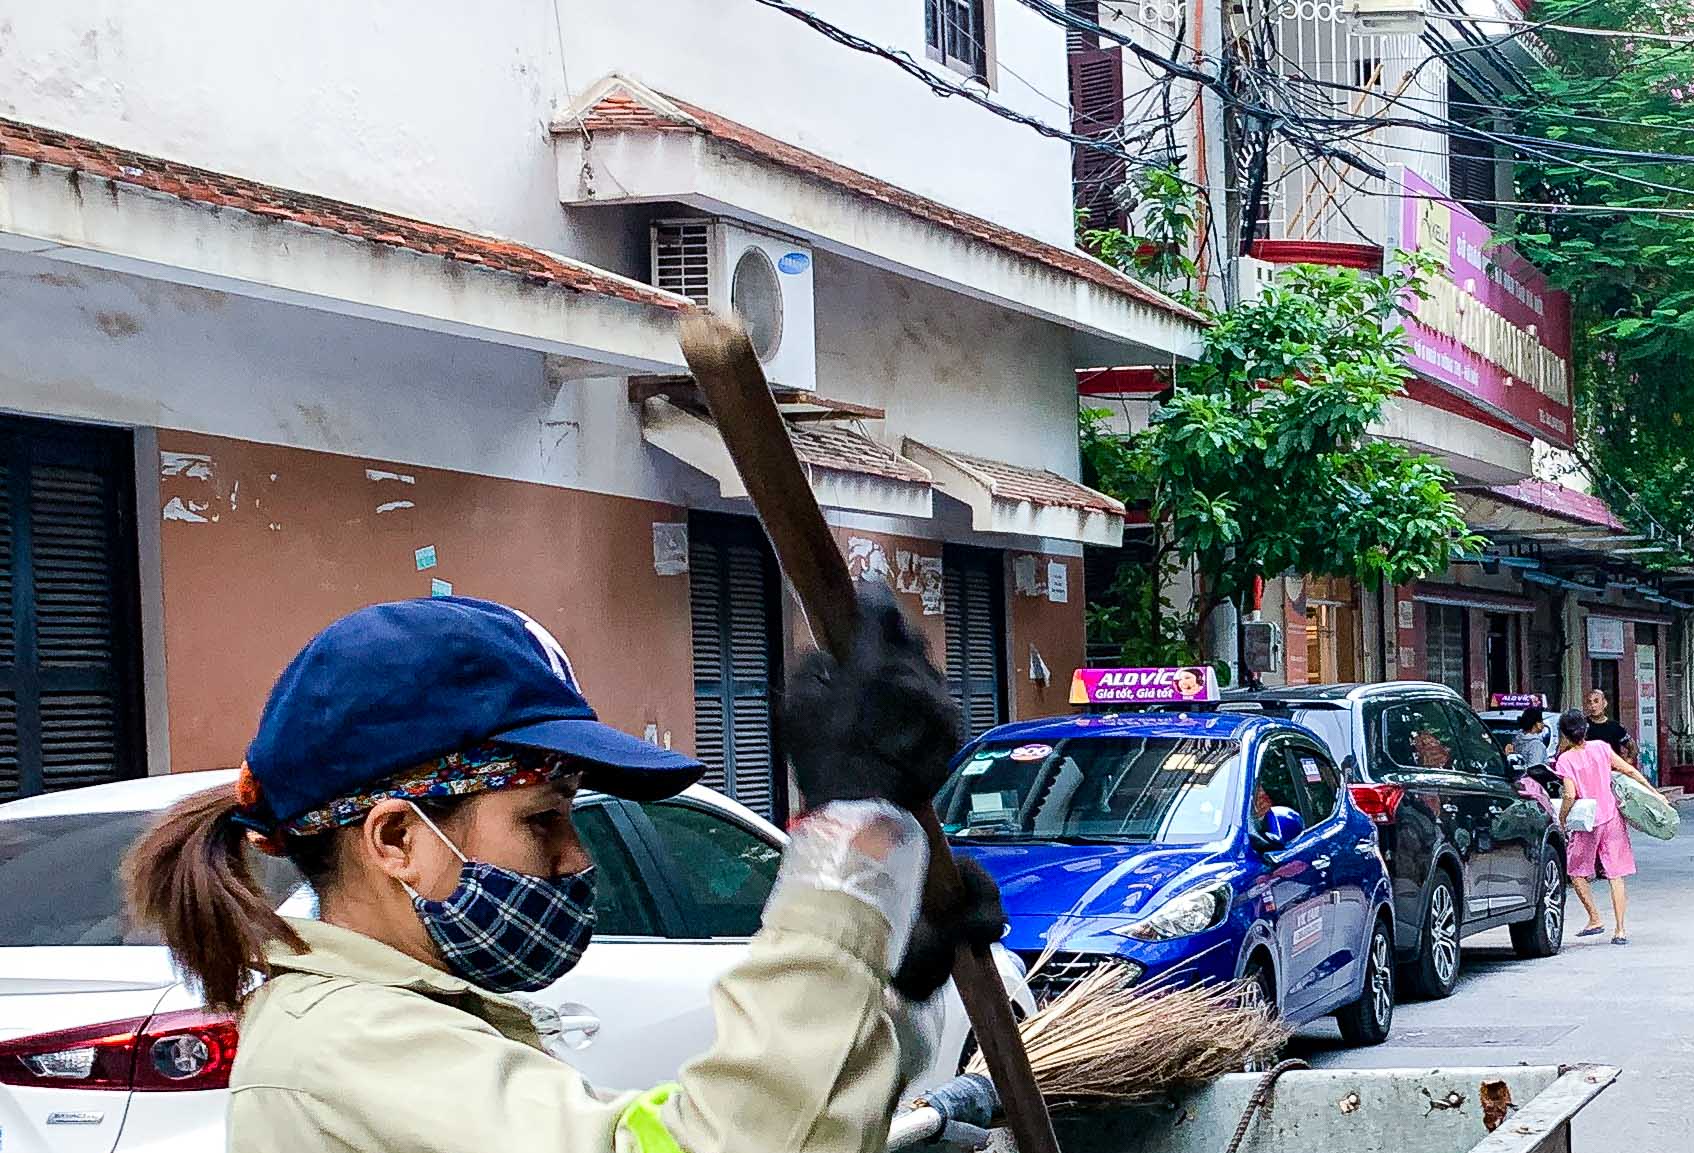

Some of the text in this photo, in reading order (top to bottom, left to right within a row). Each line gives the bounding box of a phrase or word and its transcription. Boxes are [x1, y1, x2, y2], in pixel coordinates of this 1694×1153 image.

[1095, 688, 1114, 699] Giá
[1136, 688, 1155, 699] Giá
[1157, 687, 1174, 699] tốt
